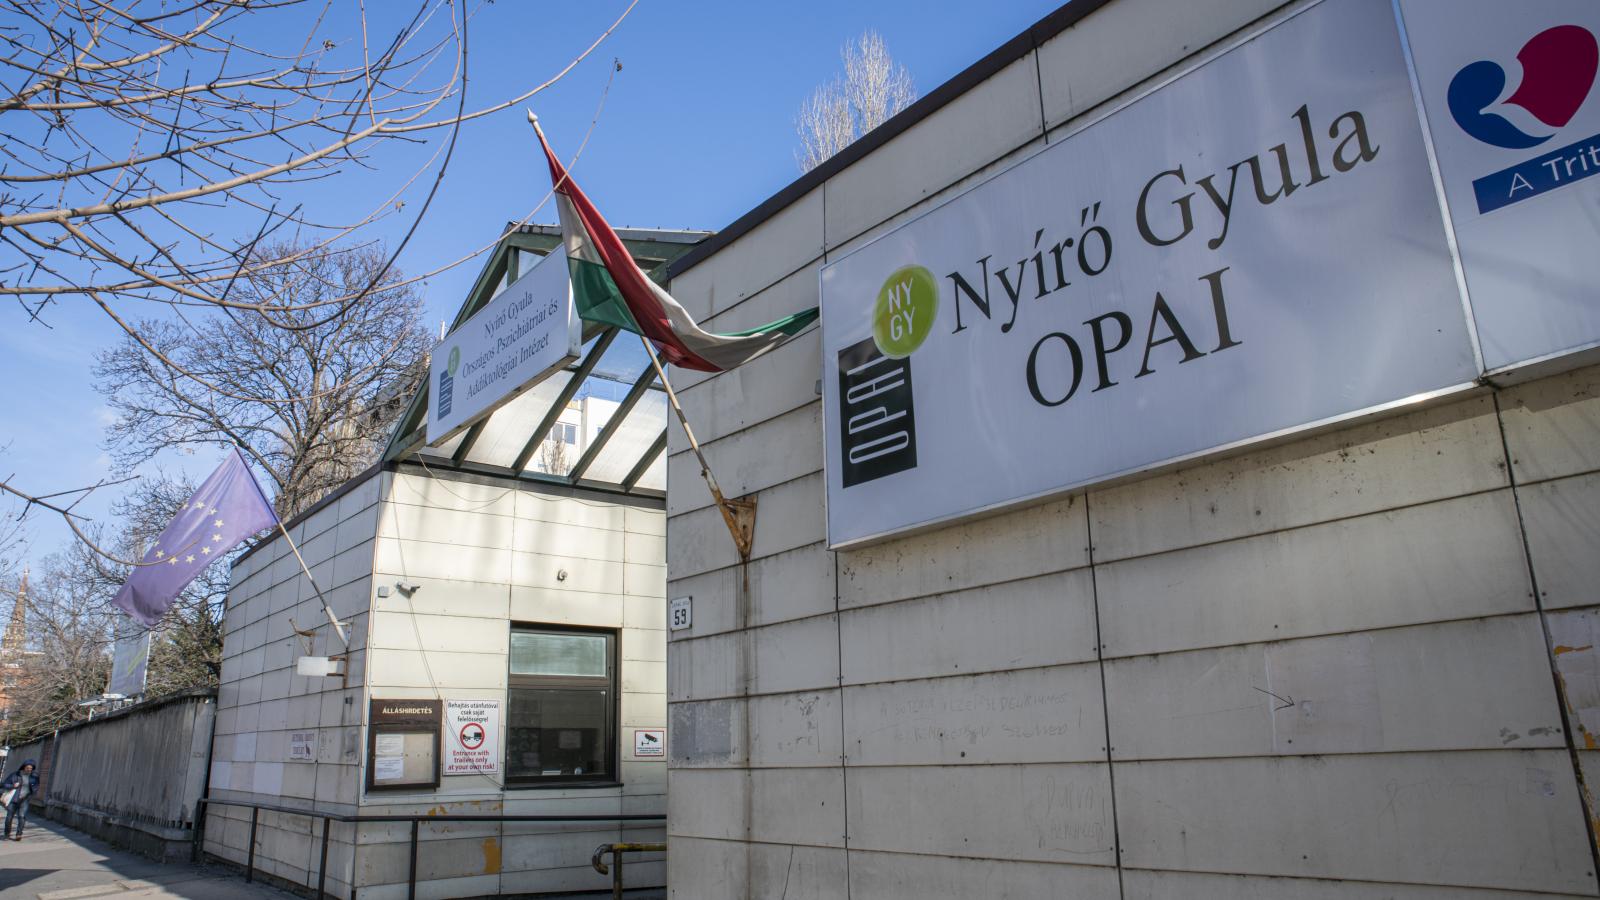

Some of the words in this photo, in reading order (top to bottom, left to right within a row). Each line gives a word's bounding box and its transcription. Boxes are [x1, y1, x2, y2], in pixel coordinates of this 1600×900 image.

[1509, 172, 1534, 198] A
[945, 202, 1113, 335] Nyírő
[1136, 103, 1381, 250] Gyula
[887, 277, 914, 314] NY
[484, 308, 507, 339] Nyírő
[507, 291, 533, 319] Gyula
[890, 306, 916, 342] GY
[462, 346, 495, 378] Országos
[497, 304, 547, 354] Pszichiátriai
[548, 298, 558, 316] és
[1026, 266, 1243, 408] OPAI
[466, 351, 518, 400] Addiktológiai
[520, 332, 549, 363] Intézet
[674, 608, 687, 626] 59
[382, 705, 433, 715] ÁLLÁSHIRDETÉS
[475, 756, 488, 764] only
